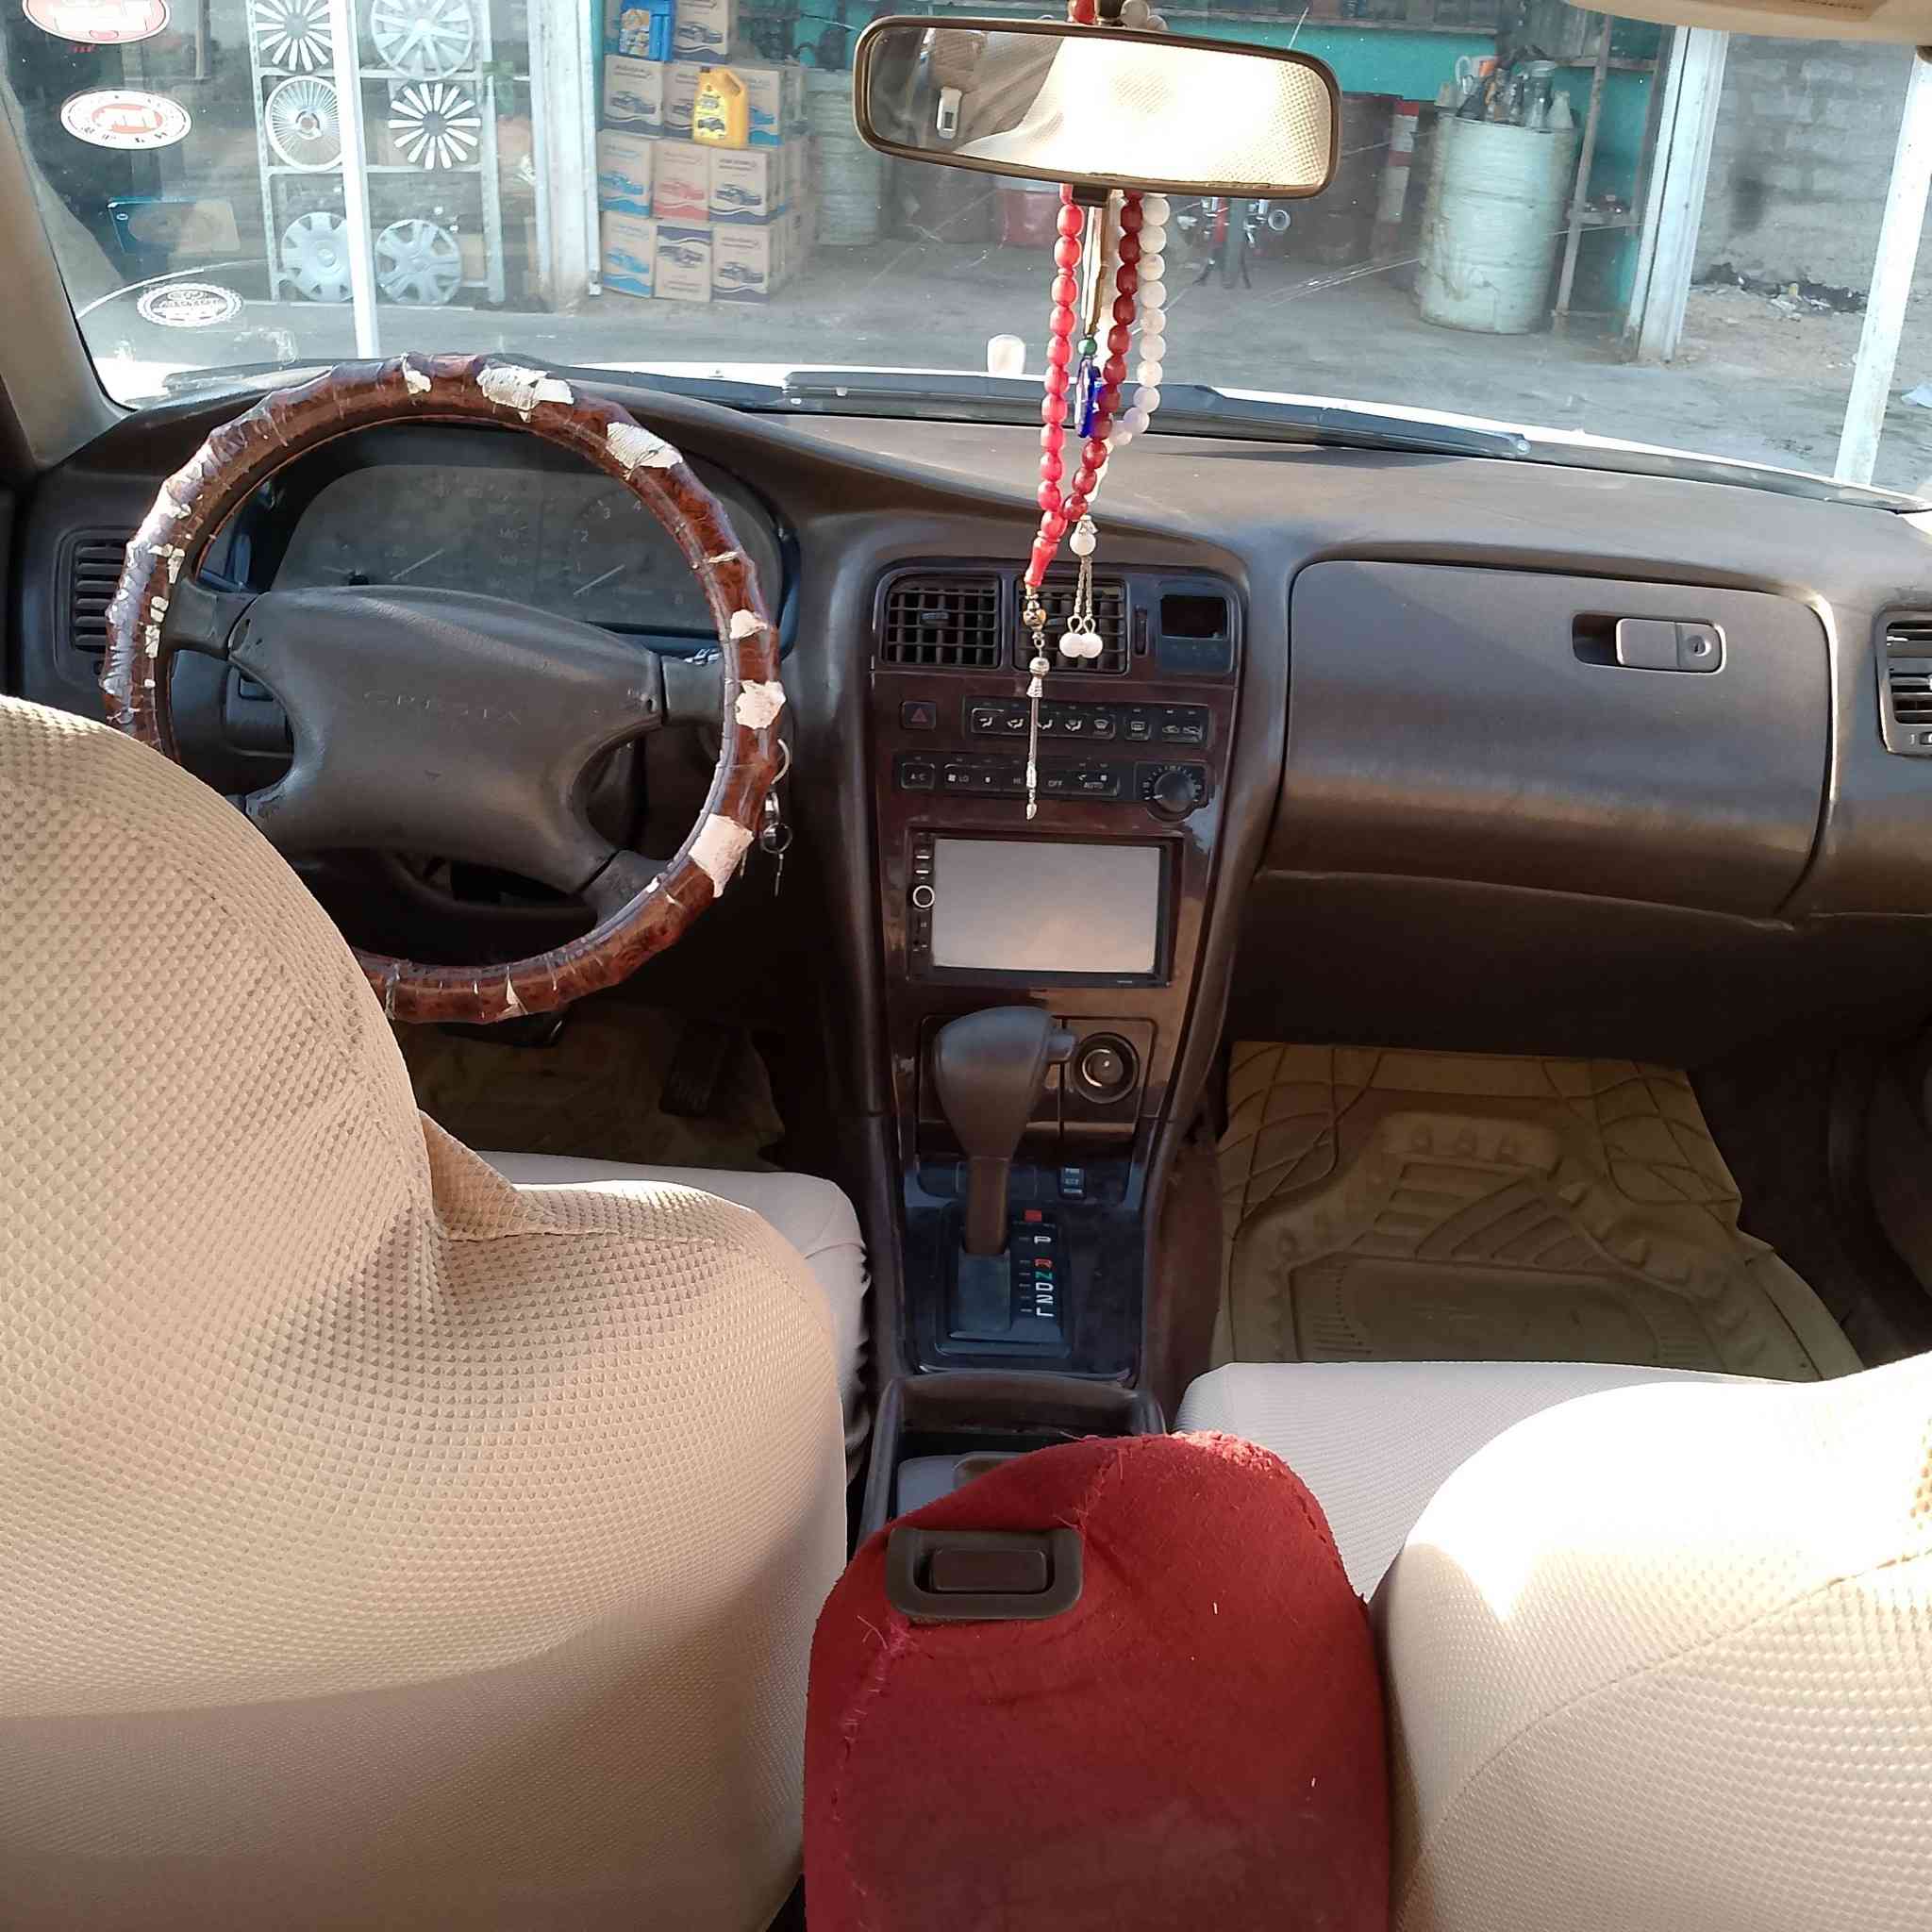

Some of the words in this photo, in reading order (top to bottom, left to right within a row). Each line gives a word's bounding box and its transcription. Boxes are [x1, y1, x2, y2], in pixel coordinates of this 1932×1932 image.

[603, 507, 611, 520] 3
[1033, 1235, 1052, 1245] P
[1035, 1281, 1055, 1291] D
[1036, 1307, 1055, 1318] L
